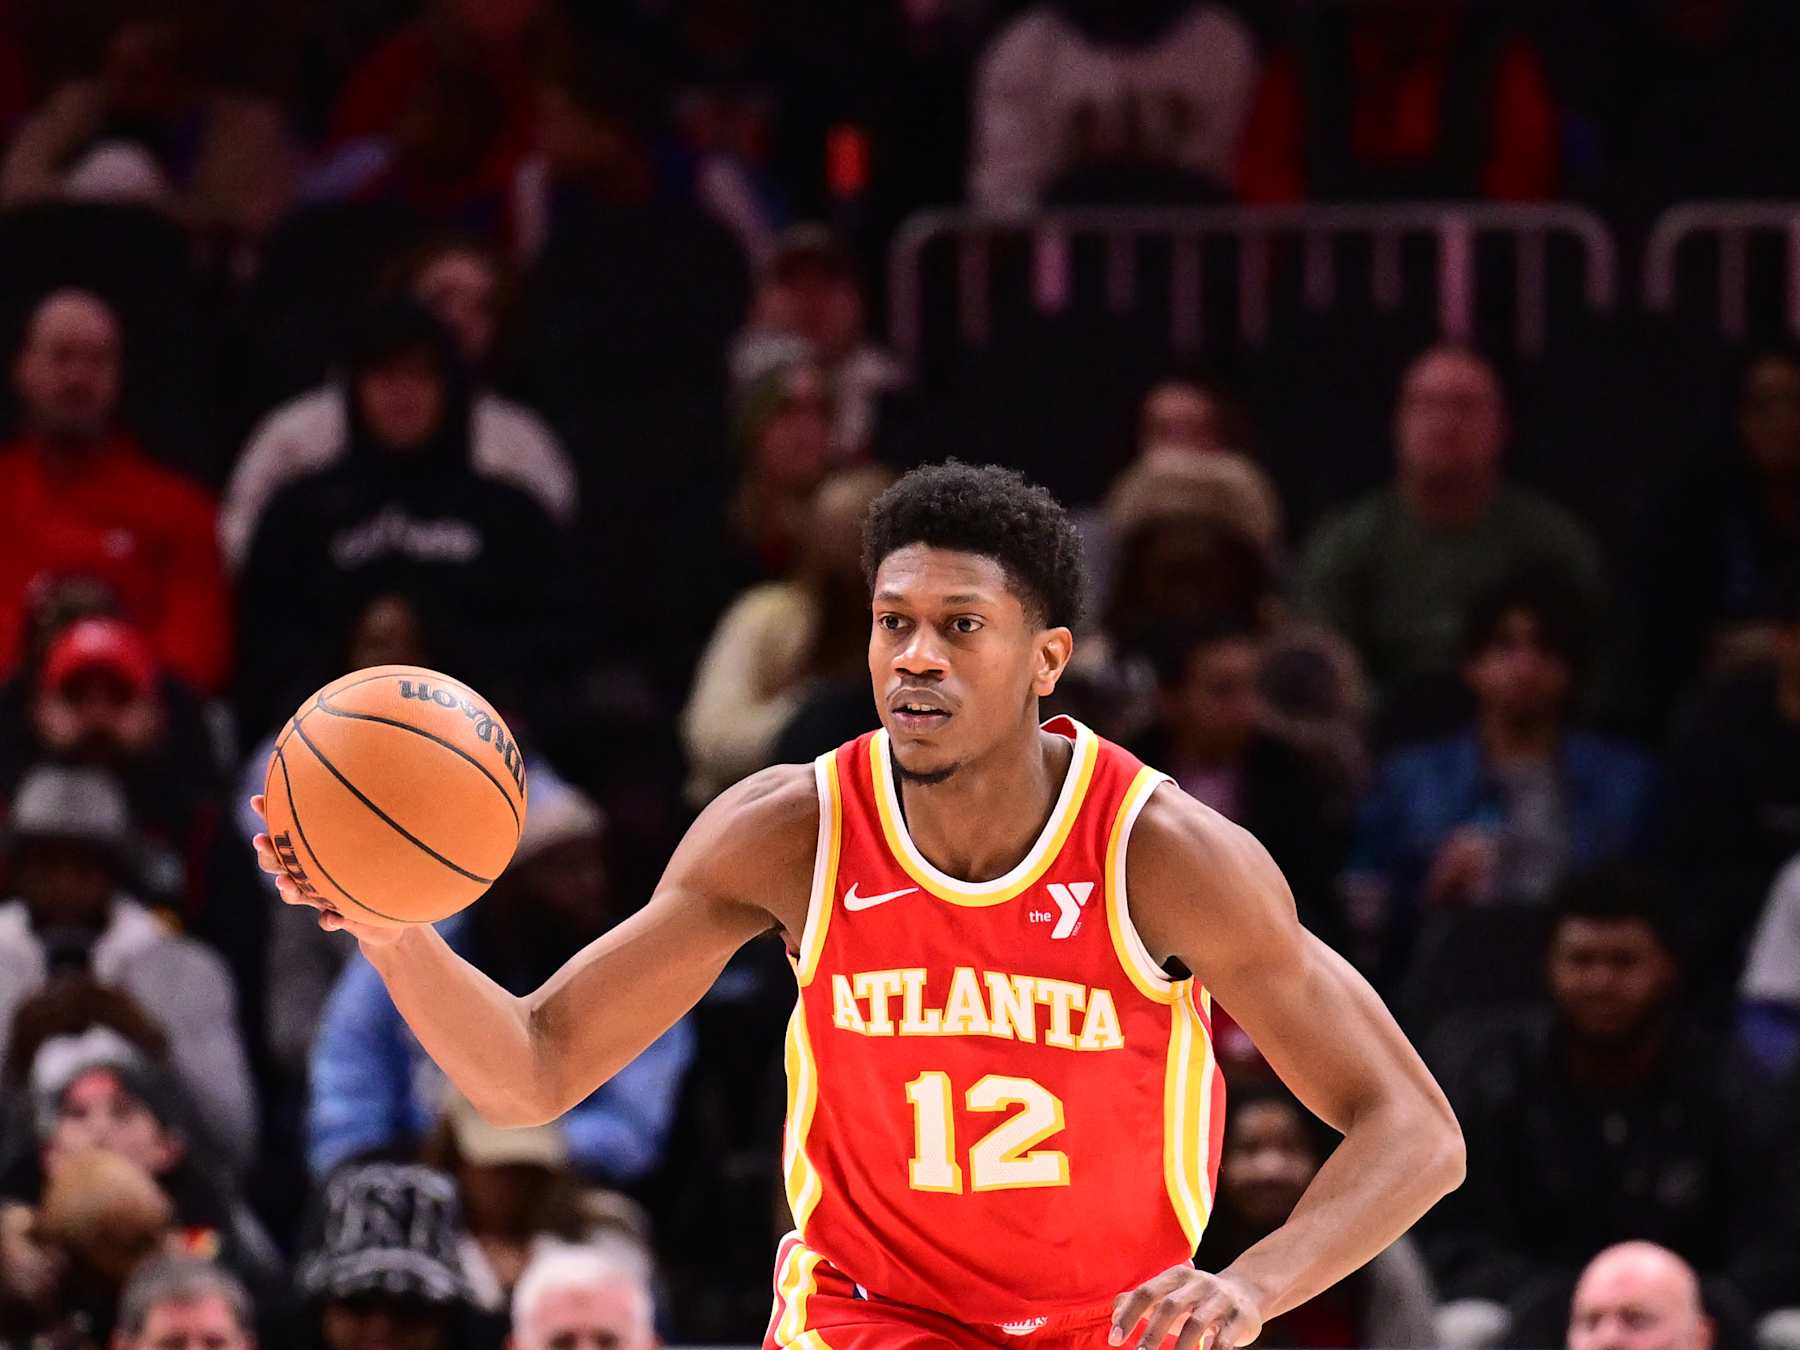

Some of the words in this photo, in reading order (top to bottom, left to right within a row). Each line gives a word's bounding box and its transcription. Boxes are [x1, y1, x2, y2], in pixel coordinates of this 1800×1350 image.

[1029, 910, 1052, 923] the
[1046, 881, 1095, 939] Y
[831, 967, 1125, 1051] ATLANTA
[904, 1070, 1071, 1195] 12
